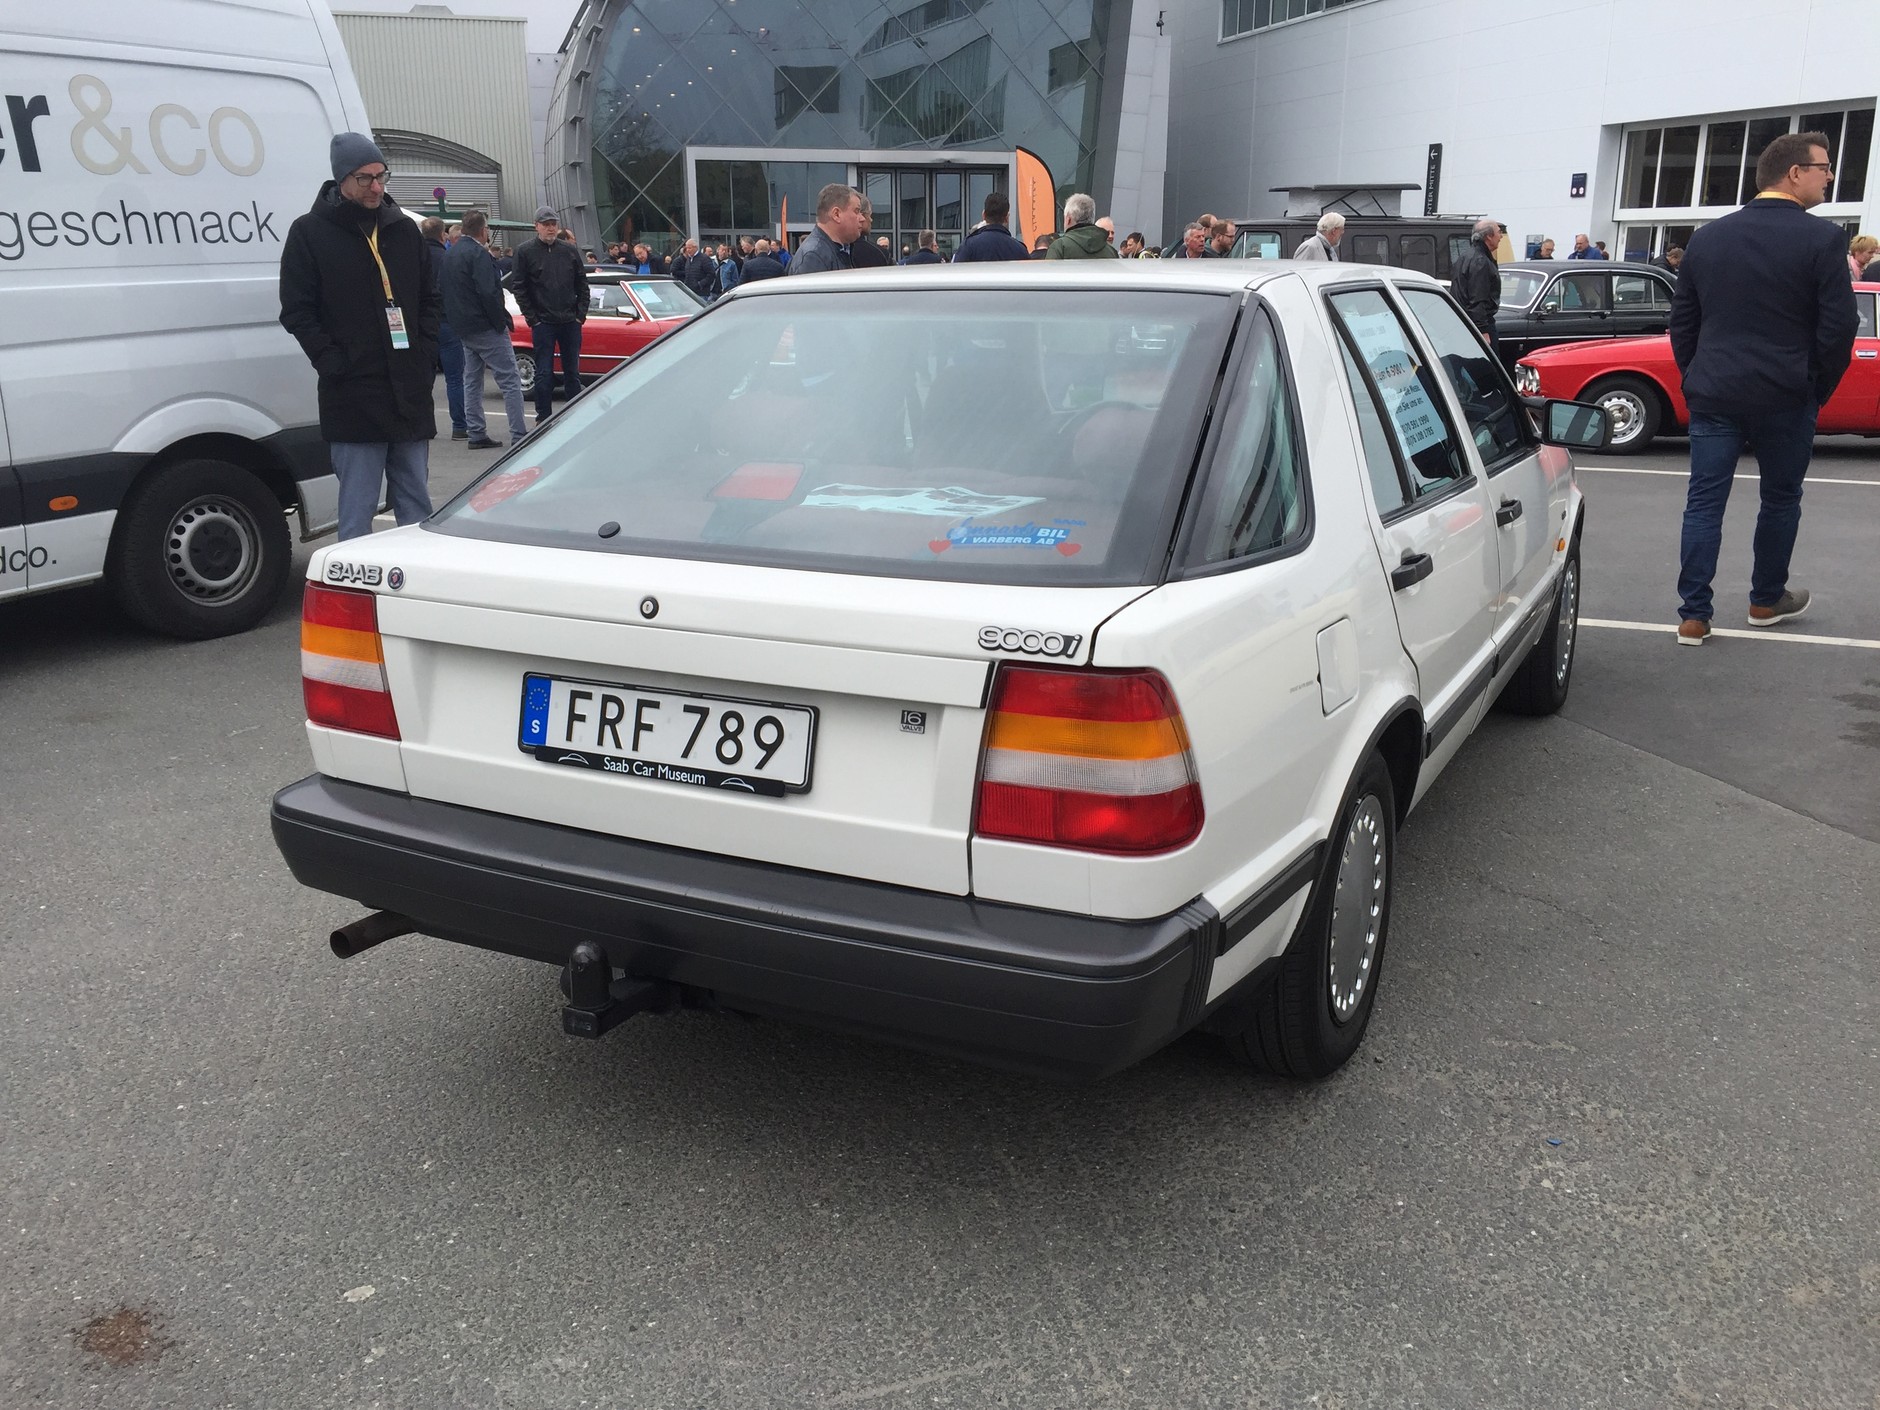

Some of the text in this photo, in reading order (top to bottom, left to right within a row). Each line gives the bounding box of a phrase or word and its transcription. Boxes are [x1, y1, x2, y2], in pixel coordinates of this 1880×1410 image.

[0, 73, 265, 177] r &co
[0, 199, 280, 261] geschmack
[972, 536, 1032, 545] VARBERG
[1035, 537, 1055, 545] AB
[1036, 528, 1068, 539] BIL
[327, 561, 383, 586] SAAB
[531, 719, 541, 734] S
[903, 711, 922, 725] 16
[565, 689, 785, 770] FRF 789
[901, 724, 924, 733] VALVE
[603, 757, 706, 785] Saab Car Museum
